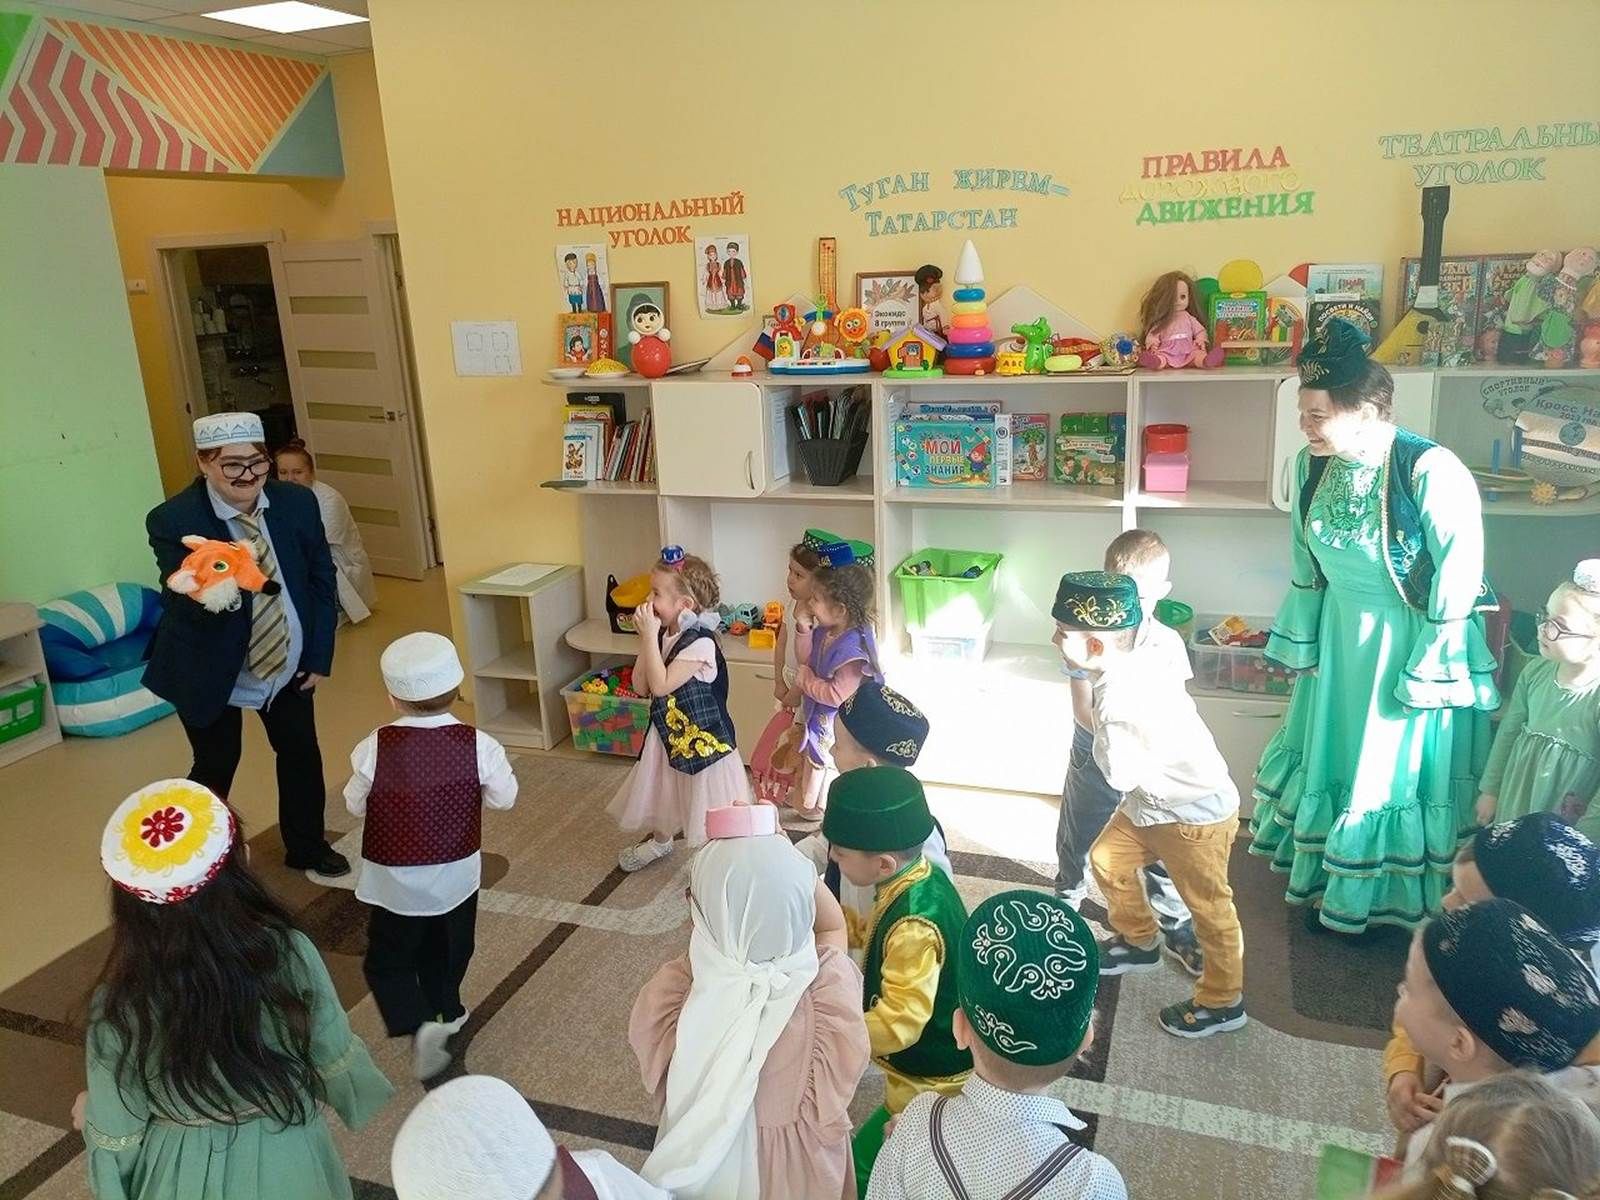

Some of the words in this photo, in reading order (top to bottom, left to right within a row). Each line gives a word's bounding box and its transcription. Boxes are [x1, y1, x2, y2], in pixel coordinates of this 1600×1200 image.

[1141, 145, 1291, 179] ПРАВИЛА
[1413, 157, 1547, 187] УГОЛОК
[556, 191, 745, 227] НАЦИОНАЛЬНЫЙ
[1136, 191, 1316, 226] ДВИЖЕНИЯ
[608, 225, 693, 249] УГОЛОК
[925, 439, 961, 455] МОИ
[929, 455, 965, 465] ПЕРВЫЕ
[924, 464, 965, 475] ЗНАНИЯ
